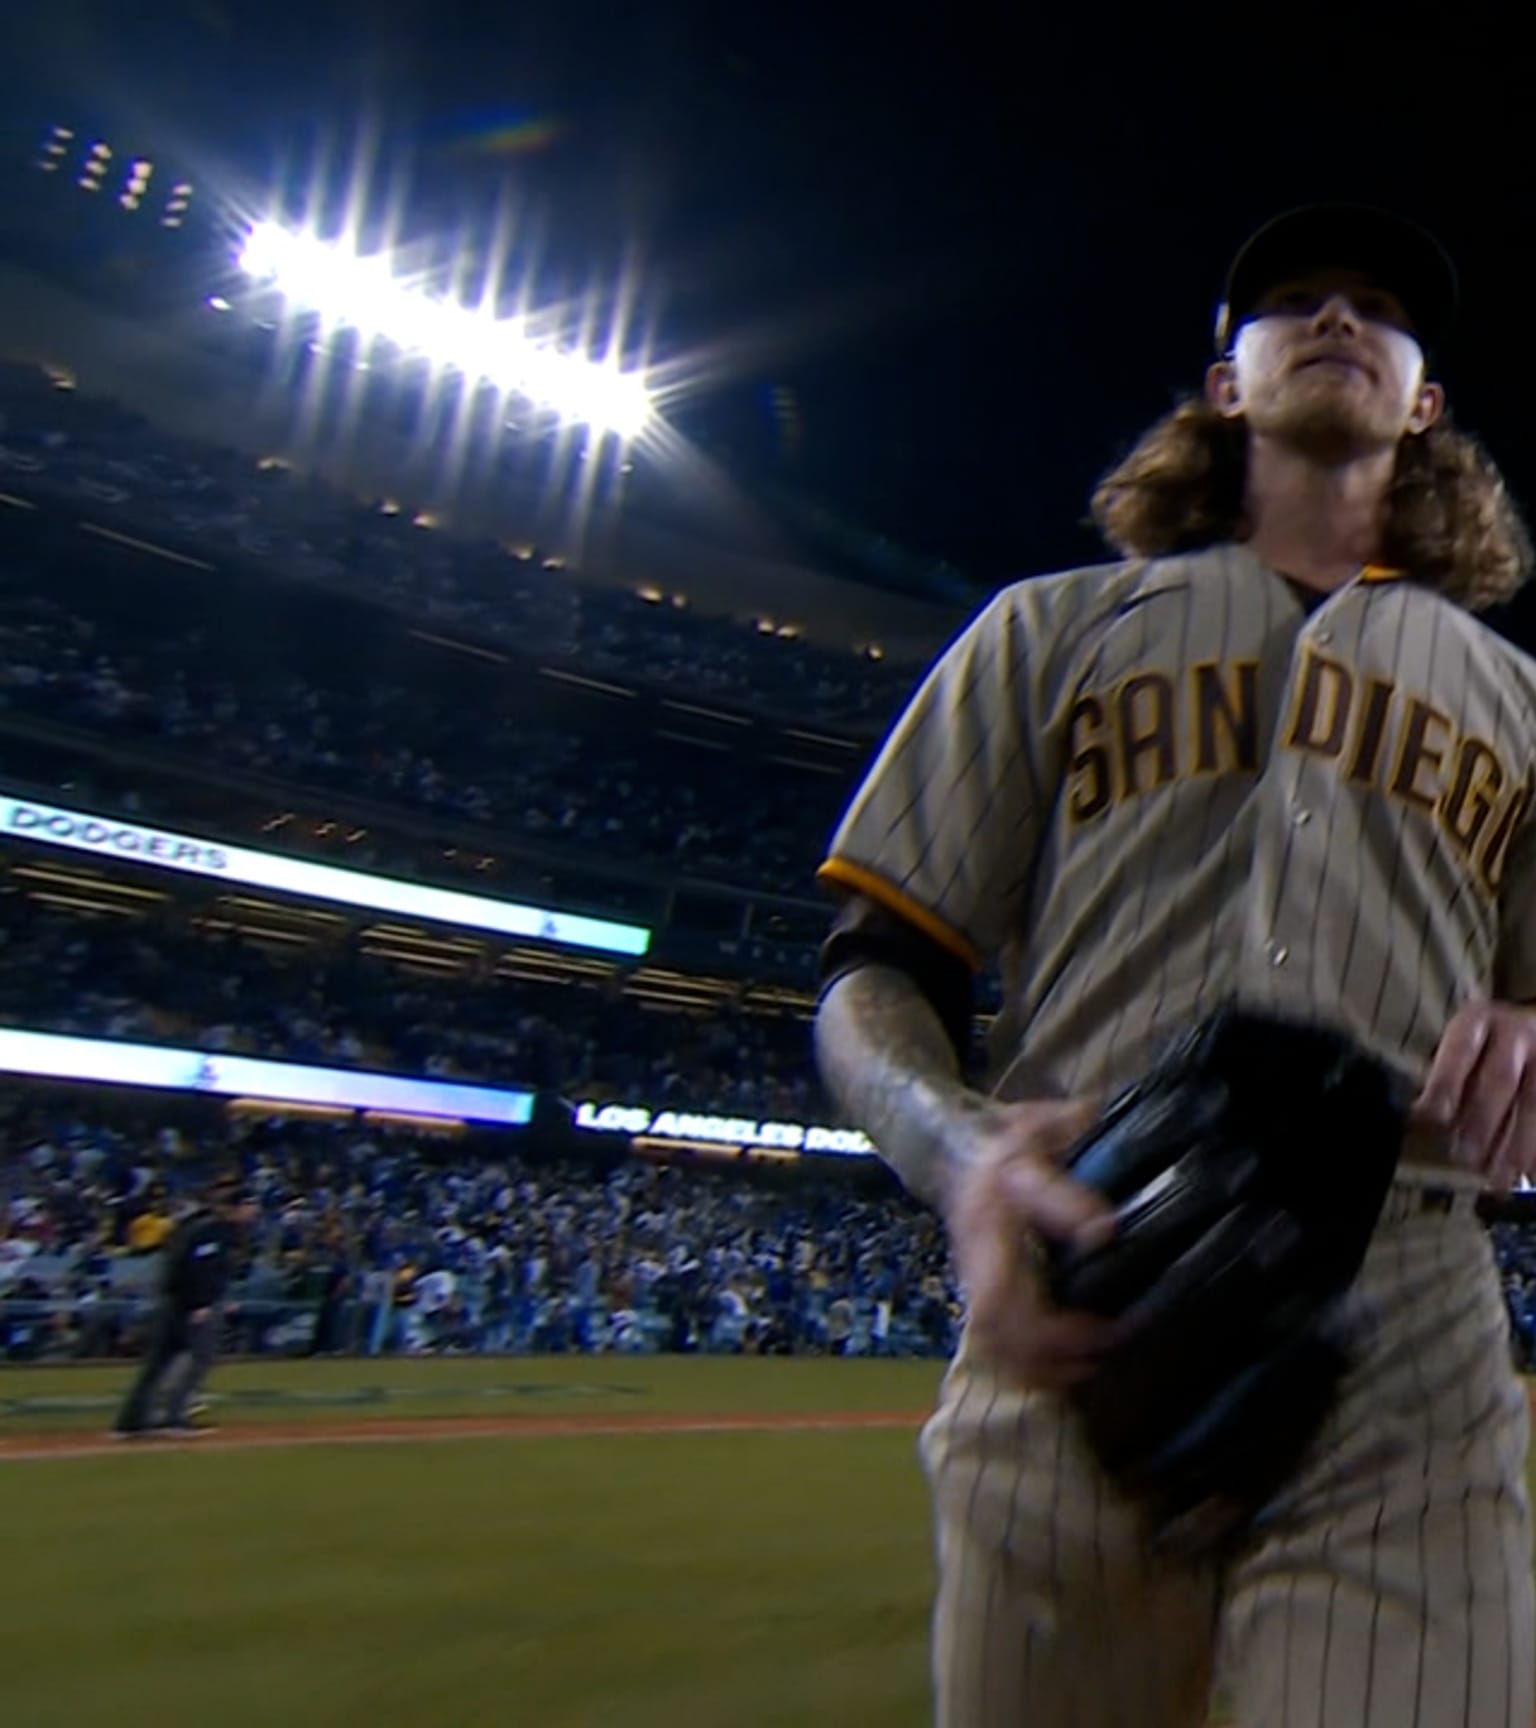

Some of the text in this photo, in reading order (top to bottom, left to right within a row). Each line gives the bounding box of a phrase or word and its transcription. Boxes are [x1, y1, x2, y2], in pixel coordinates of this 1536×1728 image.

[1065, 642, 1534, 897] SAN DIEGO
[12, 807, 227, 869] DODGERS
[576, 1103, 650, 1132] LOS
[650, 1112, 802, 1146] ANGELES
